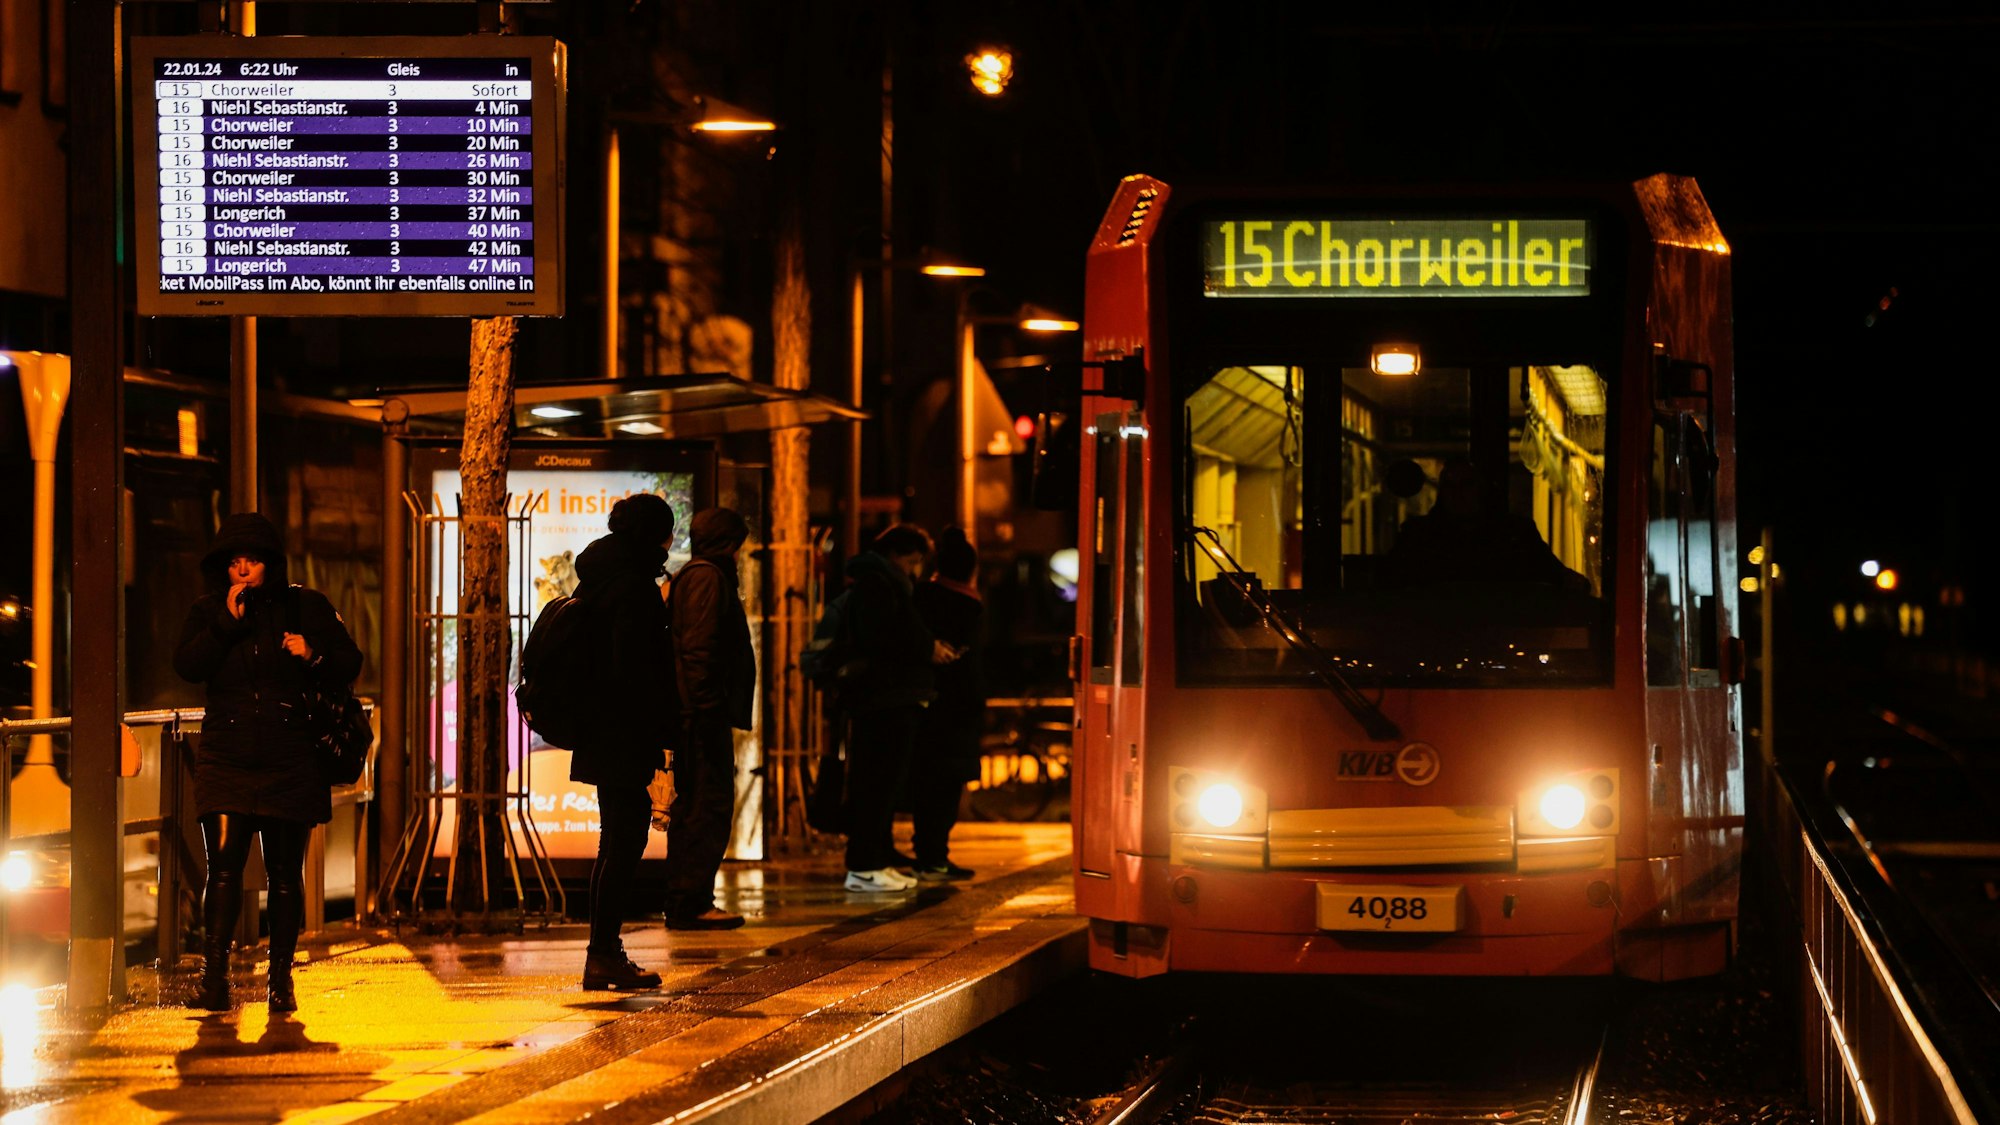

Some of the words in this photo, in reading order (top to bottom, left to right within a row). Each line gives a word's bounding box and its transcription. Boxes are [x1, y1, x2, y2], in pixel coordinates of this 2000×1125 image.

[163, 63, 222, 75] 22.01.24
[240, 64, 270, 75] 6:22
[272, 63, 299, 75] Uhr
[387, 63, 421, 75] Gleis
[505, 64, 519, 75] in
[172, 84, 190, 98] 15
[211, 84, 294, 96] Chorweiler
[388, 84, 397, 96] 3
[472, 84, 518, 96] Sofort
[172, 102, 190, 115] 16
[211, 100, 251, 114] Niehl
[253, 101, 348, 114] Sebastianstr.
[388, 101, 398, 114] 3
[475, 101, 486, 114] 4
[489, 101, 519, 114] Min
[173, 119, 191, 132] 15
[211, 118, 294, 132] Chorweiler
[388, 119, 399, 132] 3
[467, 119, 487, 132] 10
[489, 119, 519, 132] Min
[173, 137, 191, 149] 15
[211, 136, 295, 149] Chorweiler
[388, 136, 399, 149] 3
[466, 136, 487, 149] 20
[489, 136, 519, 150] Min
[174, 154, 192, 167] 16
[212, 153, 252, 167] Niehl
[254, 153, 349, 167] Sebastianstr.
[388, 154, 399, 167] 3
[467, 154, 487, 167] 26
[490, 154, 520, 167] Min
[174, 172, 192, 184] 15
[212, 171, 295, 185] Chorweiler
[389, 172, 399, 184] 3
[467, 172, 487, 185] 30
[490, 171, 520, 185] Min
[175, 190, 192, 202] 16
[213, 188, 253, 202] Niehl
[255, 188, 350, 202] Sebastianstr.
[389, 189, 400, 202] 3
[467, 189, 487, 202] 32
[490, 189, 520, 202] Min
[175, 207, 192, 219] 15
[213, 206, 286, 222] Longerich
[389, 207, 400, 220] 3
[468, 207, 487, 220] 37
[490, 206, 520, 220] Min
[175, 225, 193, 237] 15
[213, 223, 296, 237] Chorweiler
[390, 224, 400, 237] 3
[467, 224, 488, 237] 40
[491, 224, 521, 237] Min
[176, 242, 193, 254] 16
[214, 241, 253, 255] Niehl
[256, 241, 351, 255] Sebastianstr.
[390, 242, 401, 255] 3
[467, 242, 488, 255] 42
[491, 241, 521, 255] Min
[1220, 221, 1272, 286] 15
[1284, 220, 1583, 287] Chorweiler
[176, 260, 193, 272] 15
[214, 258, 287, 275] Longerich
[390, 259, 401, 272] 3
[468, 259, 488, 272] 47
[491, 259, 521, 272] Min
[189, 276, 265, 290] MobilPass
[268, 276, 287, 290] im
[290, 276, 325, 292] Abo,
[328, 276, 372, 290] könnt
[375, 276, 396, 290] ihr
[398, 276, 466, 290] ebenfalls
[468, 276, 516, 290] online
[519, 276, 534, 290] in
[535, 455, 592, 467] JCDecaux
[1338, 752, 1395, 776] KVB
[1348, 897, 1427, 919] 4088
[1384, 918, 1392, 929] 2
